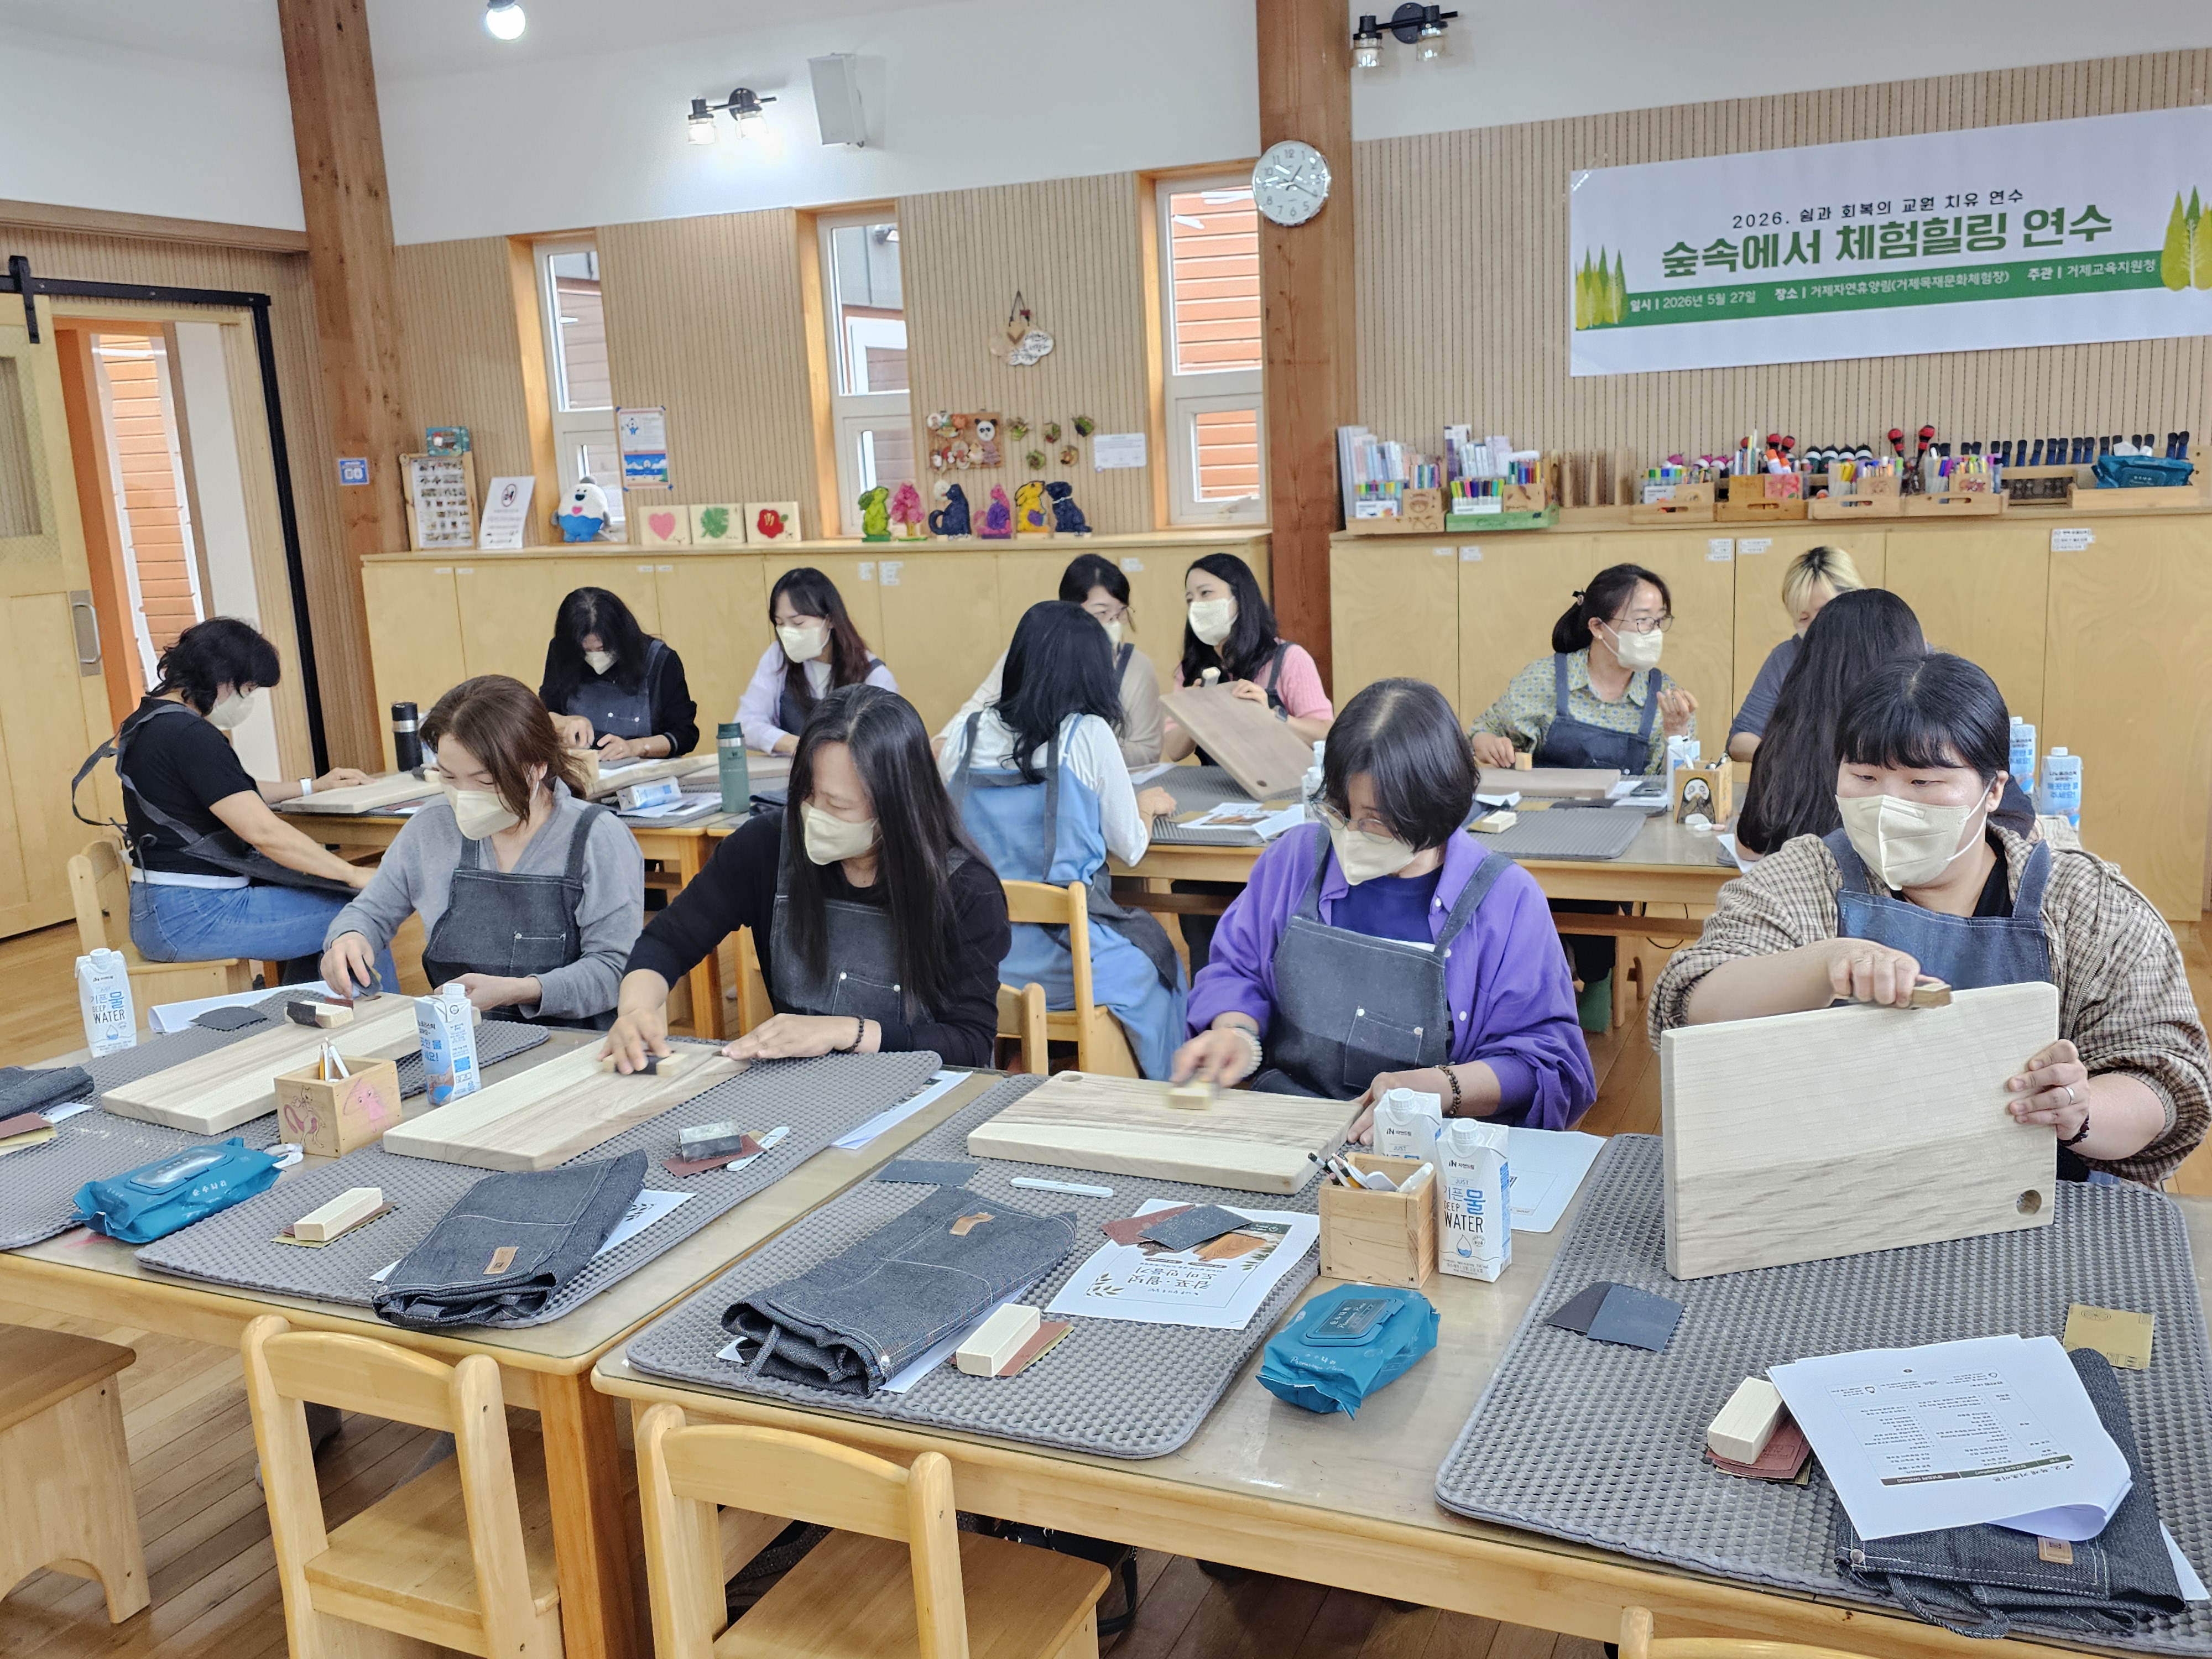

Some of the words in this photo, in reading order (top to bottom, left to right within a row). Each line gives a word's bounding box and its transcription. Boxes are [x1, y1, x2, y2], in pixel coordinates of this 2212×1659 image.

[1285, 149, 1295, 158] 12
[1273, 155, 1280, 165] 11
[1267, 196, 1272, 205] 8
[1303, 201, 1309, 211] 5
[1277, 206, 1283, 215] 7
[1291, 207, 1296, 216] 6
[1733, 212, 1790, 229] 2026.
[1799, 206, 1832, 222] 쉼과
[1841, 199, 1892, 219] 회복의
[1901, 196, 1934, 213] 교원
[1945, 192, 1979, 210] 치유
[1989, 189, 2024, 205] 연수
[1662, 229, 1821, 278] 숲속에서
[1835, 212, 2008, 262] 체험힐링
[2022, 204, 2112, 249] 연수
[1630, 298, 1651, 312] 일시
[1662, 294, 1703, 310] 2026년
[1708, 292, 1725, 306] 5월
[1730, 290, 1756, 304] 27일
[1775, 288, 1798, 302] 장소
[2027, 267, 2052, 281] 주관
[2066, 258, 2156, 278] 거제교육지원청
[93, 1009, 126, 1024] WATER
[1444, 1200, 1460, 1212] DEEP
[1464, 1189, 1486, 1215] 물
[1444, 1211, 1483, 1233] WATER
[1135, 1266, 1179, 1277] 만들기
[1185, 1270, 1217, 1280] 도마
